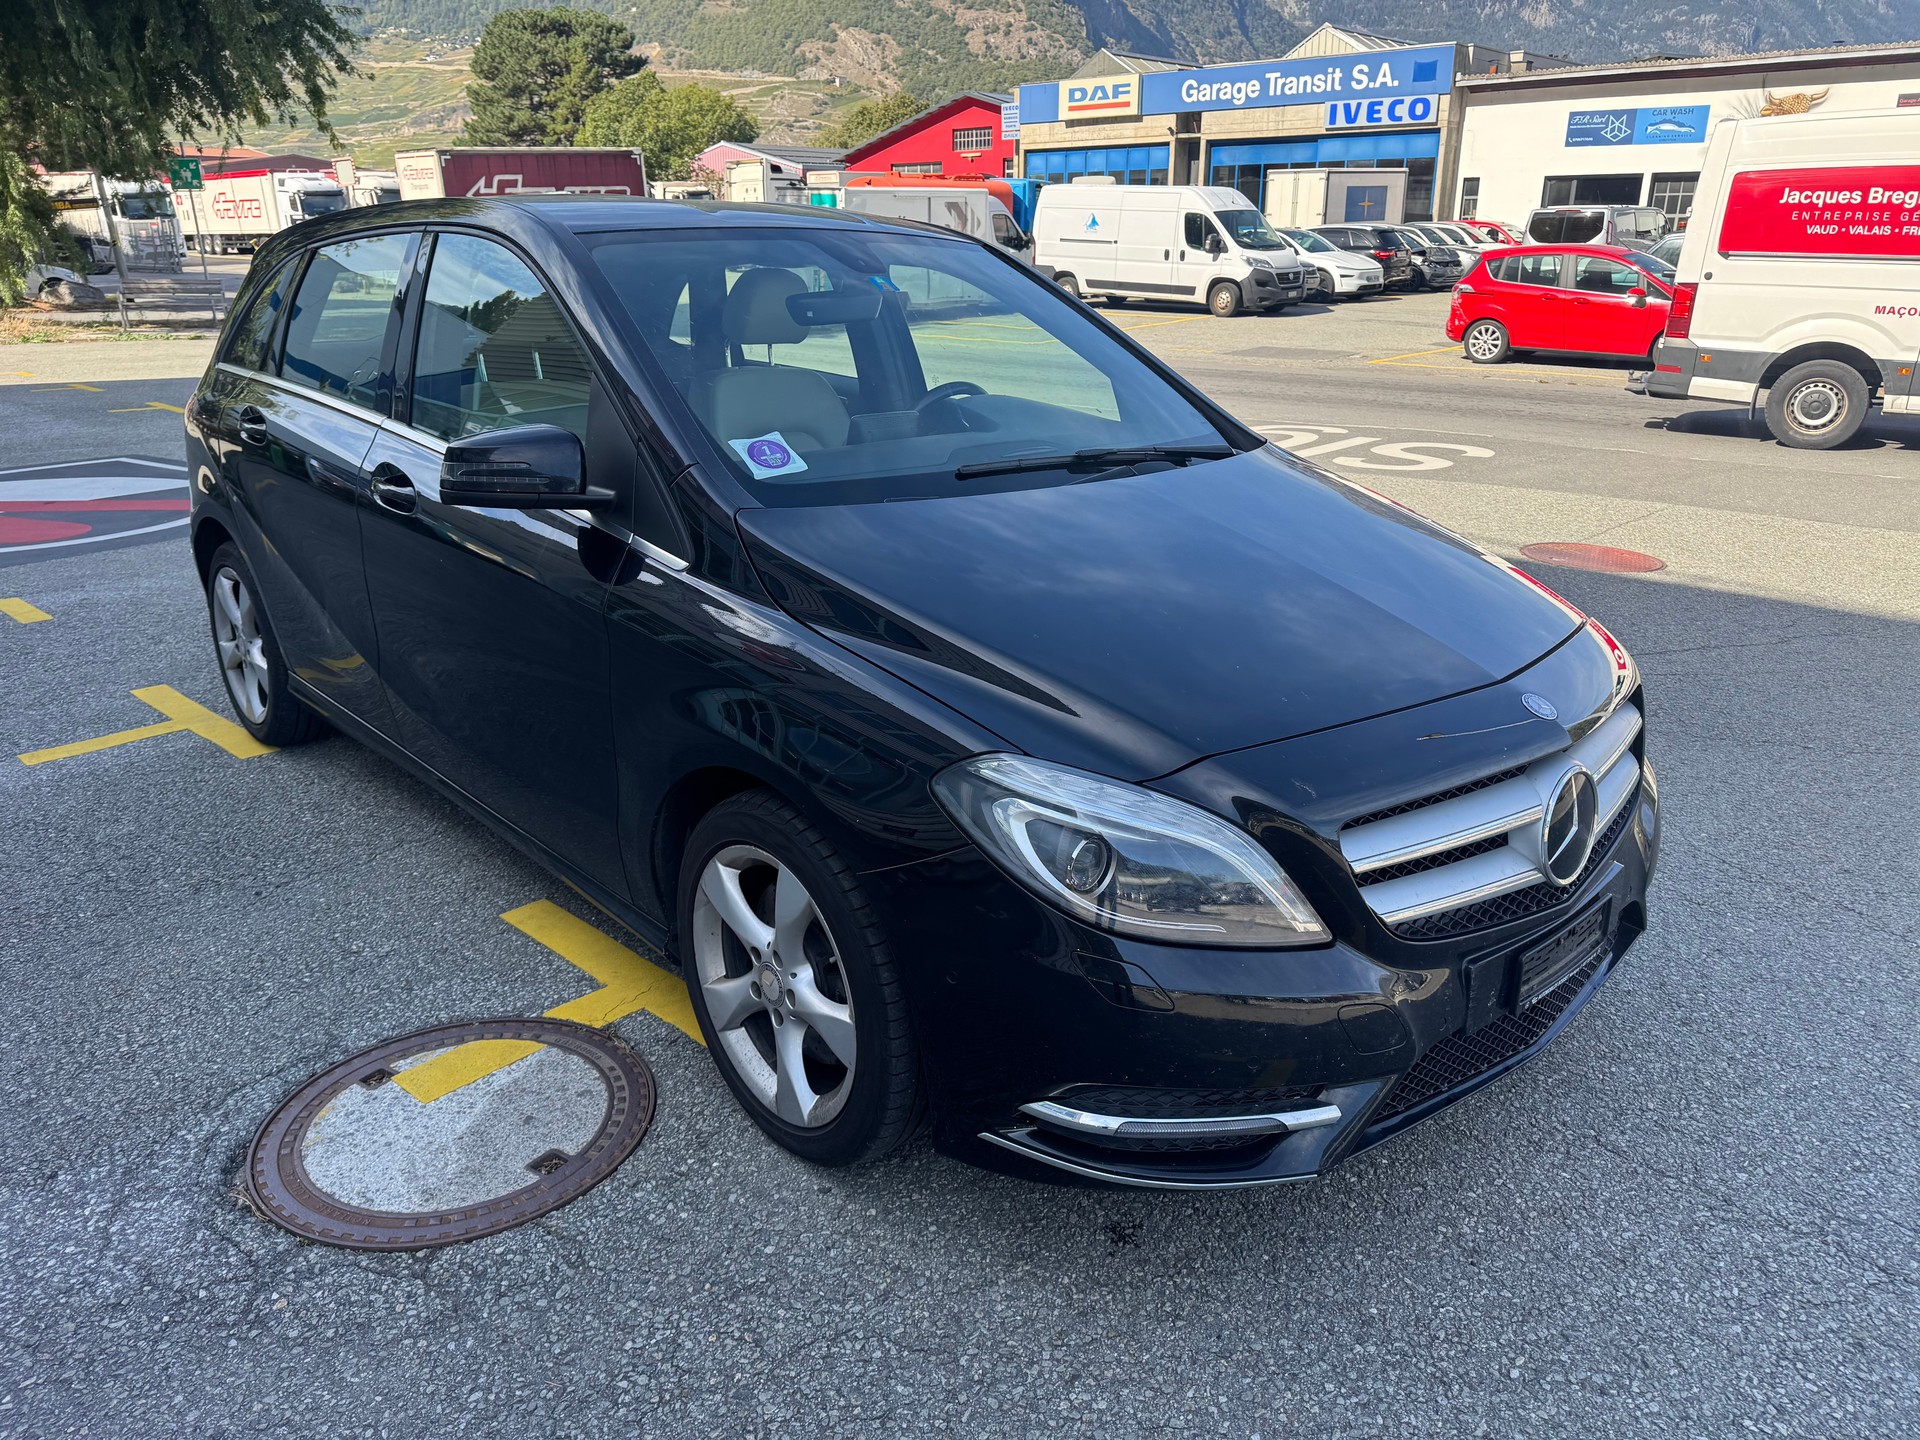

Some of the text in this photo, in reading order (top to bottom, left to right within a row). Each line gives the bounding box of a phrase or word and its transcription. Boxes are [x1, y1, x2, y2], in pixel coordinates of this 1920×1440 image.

[1181, 63, 1399, 105] Garage Transit S.A.
[1068, 83, 1131, 103] DAF
[1328, 97, 1432, 126] IVECO
[1652, 109, 1667, 117] CAR
[1779, 187, 1920, 209] Jacques Breg
[1791, 211, 1891, 221] ENTREPRISE
[1806, 224, 1838, 235] VAUD
[1849, 225, 1892, 235] VALAIS
[1874, 305, 1920, 318] MAÇO
